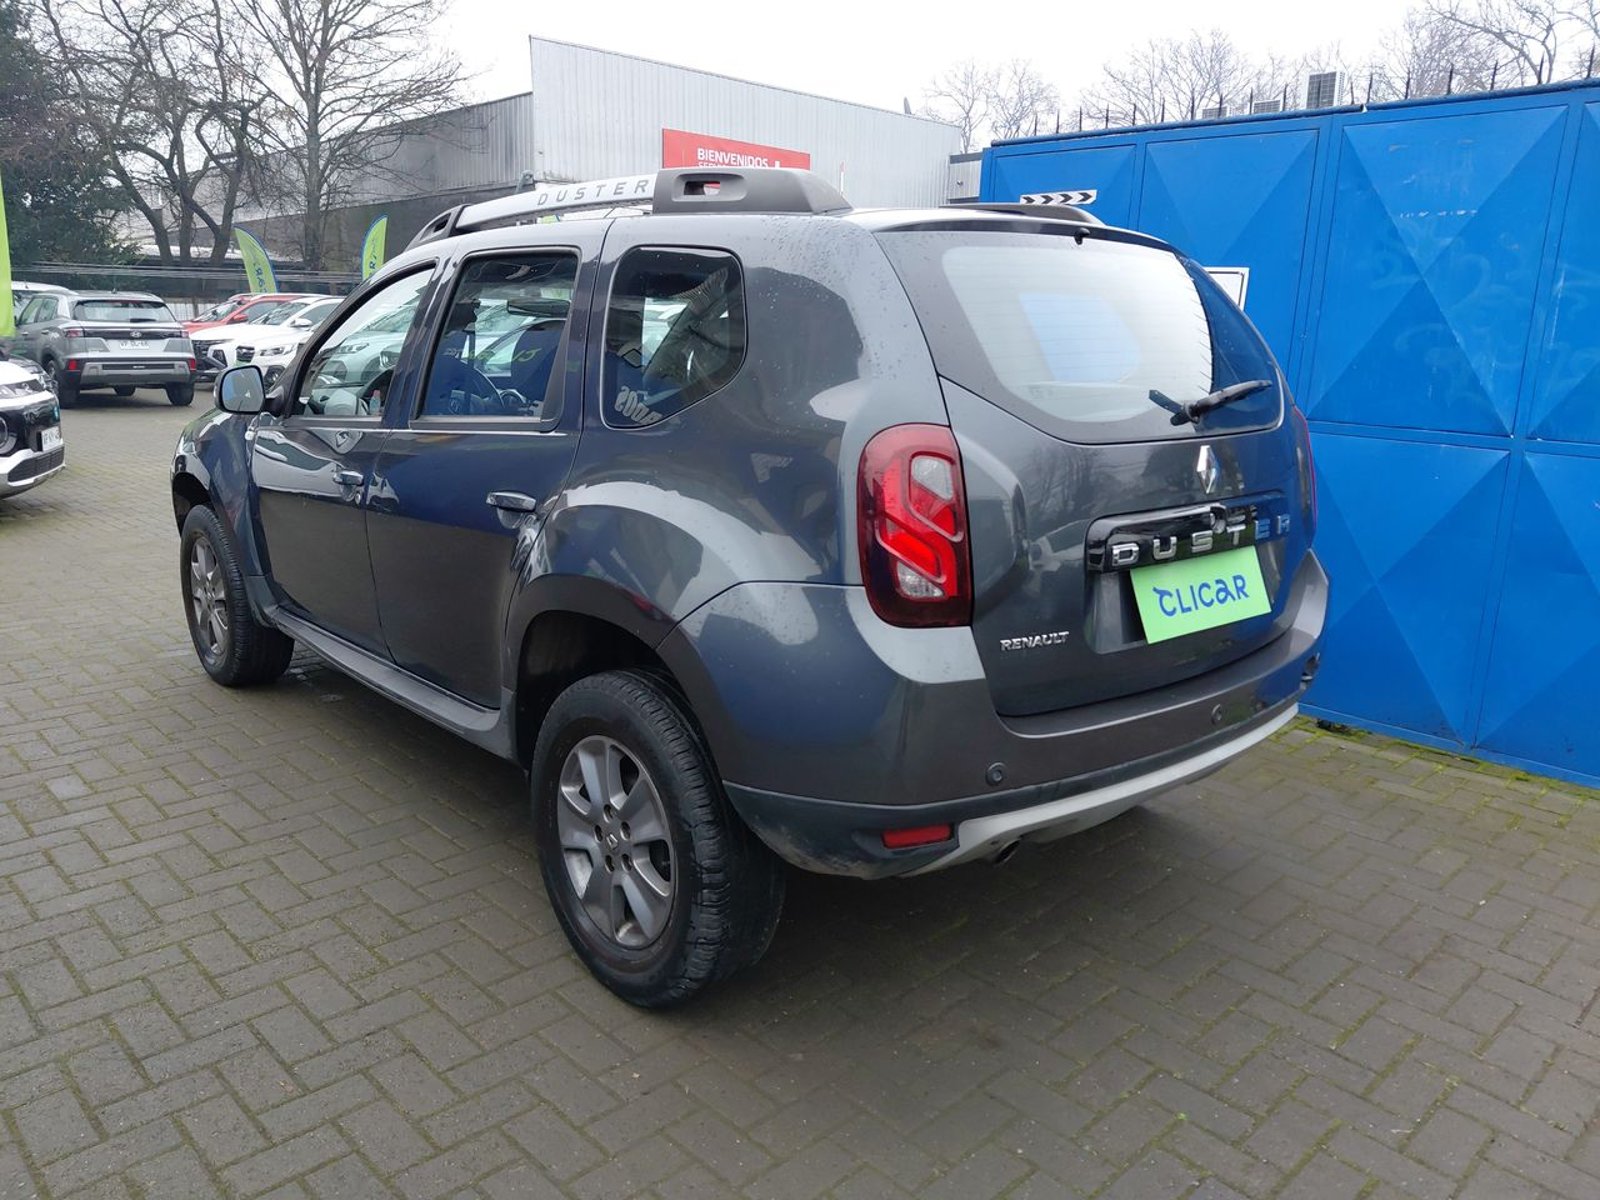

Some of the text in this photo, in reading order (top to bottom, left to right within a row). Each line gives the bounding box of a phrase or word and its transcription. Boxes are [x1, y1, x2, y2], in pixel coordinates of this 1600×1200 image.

[697, 148, 769, 168] BIENVENIDOS
[538, 179, 649, 206] DUSTER
[1112, 514, 1290, 566] DUSTER
[1000, 631, 1069, 651] RENAULT
